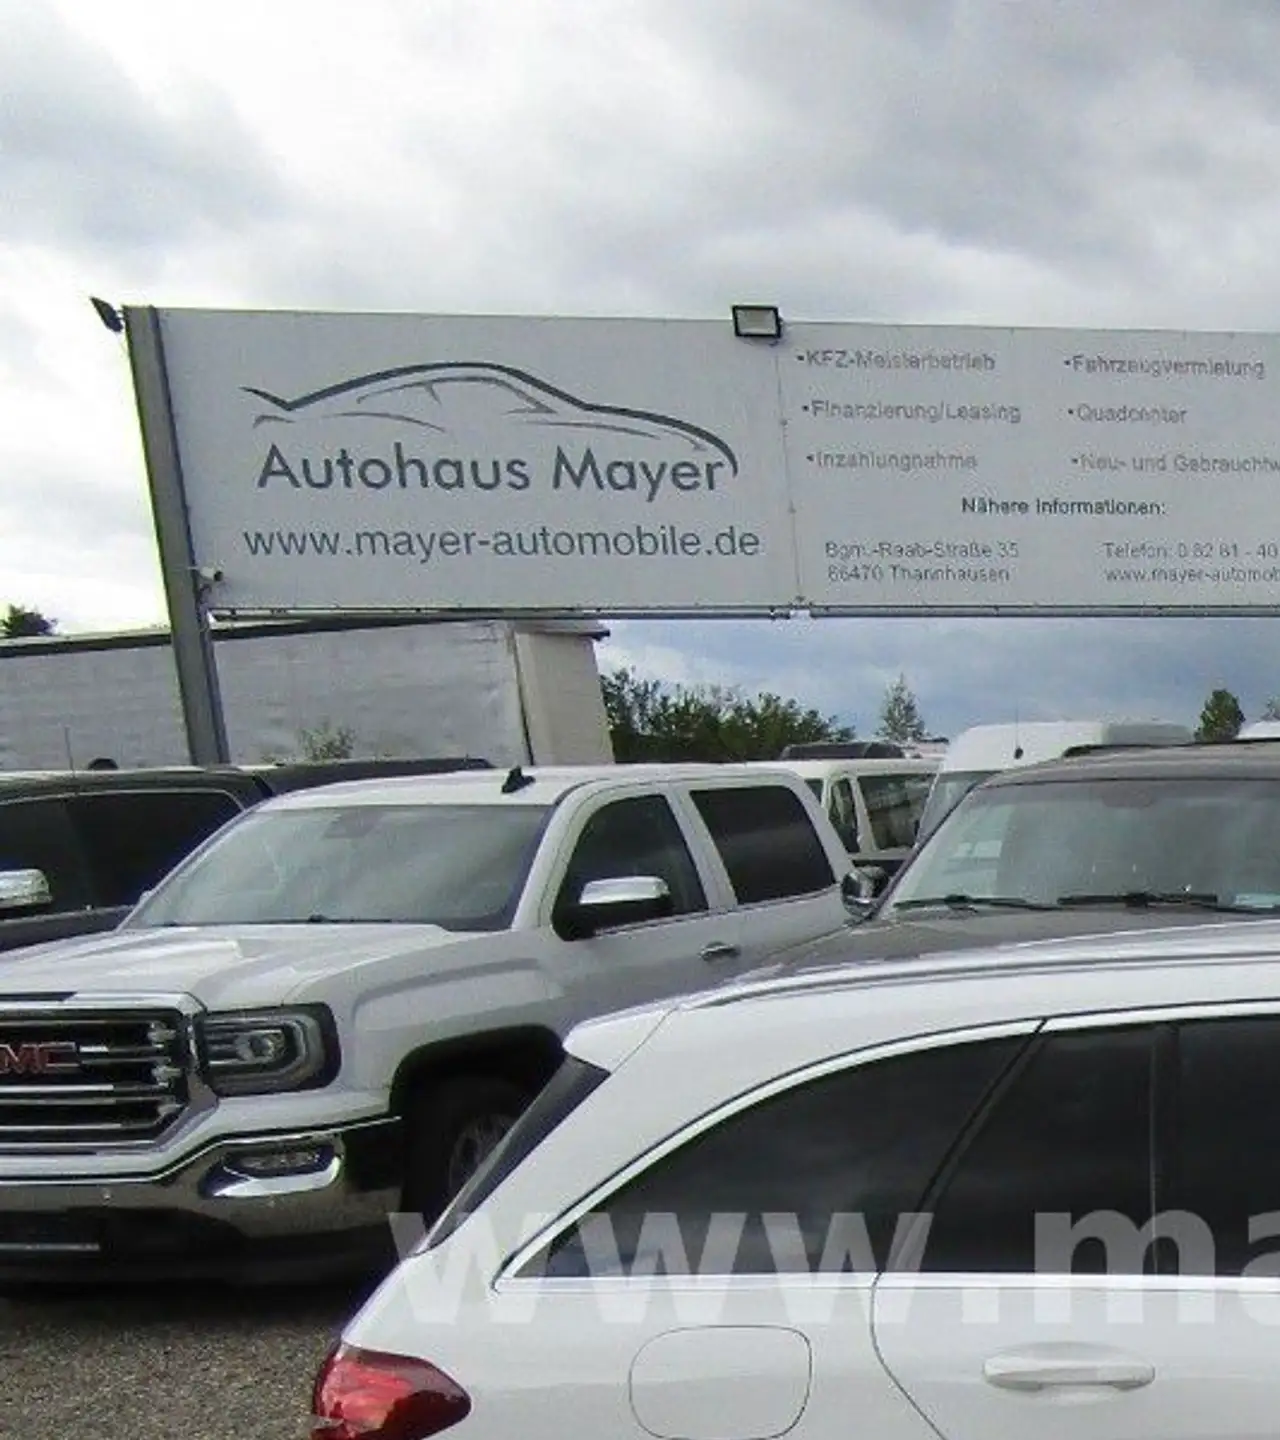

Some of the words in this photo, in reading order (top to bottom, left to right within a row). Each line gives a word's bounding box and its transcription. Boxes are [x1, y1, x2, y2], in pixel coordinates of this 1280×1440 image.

[816, 450, 978, 472] Inzahlungnahme
[1133, 455, 1168, 472] und
[256, 442, 529, 491] Autohaus
[552, 446, 724, 502] Mayer
[961, 497, 1030, 515] Nähere
[1036, 499, 1166, 516] Informationen:
[242, 525, 760, 564] www.mayer-automobile.de
[891, 564, 1010, 582] Thannhausen
